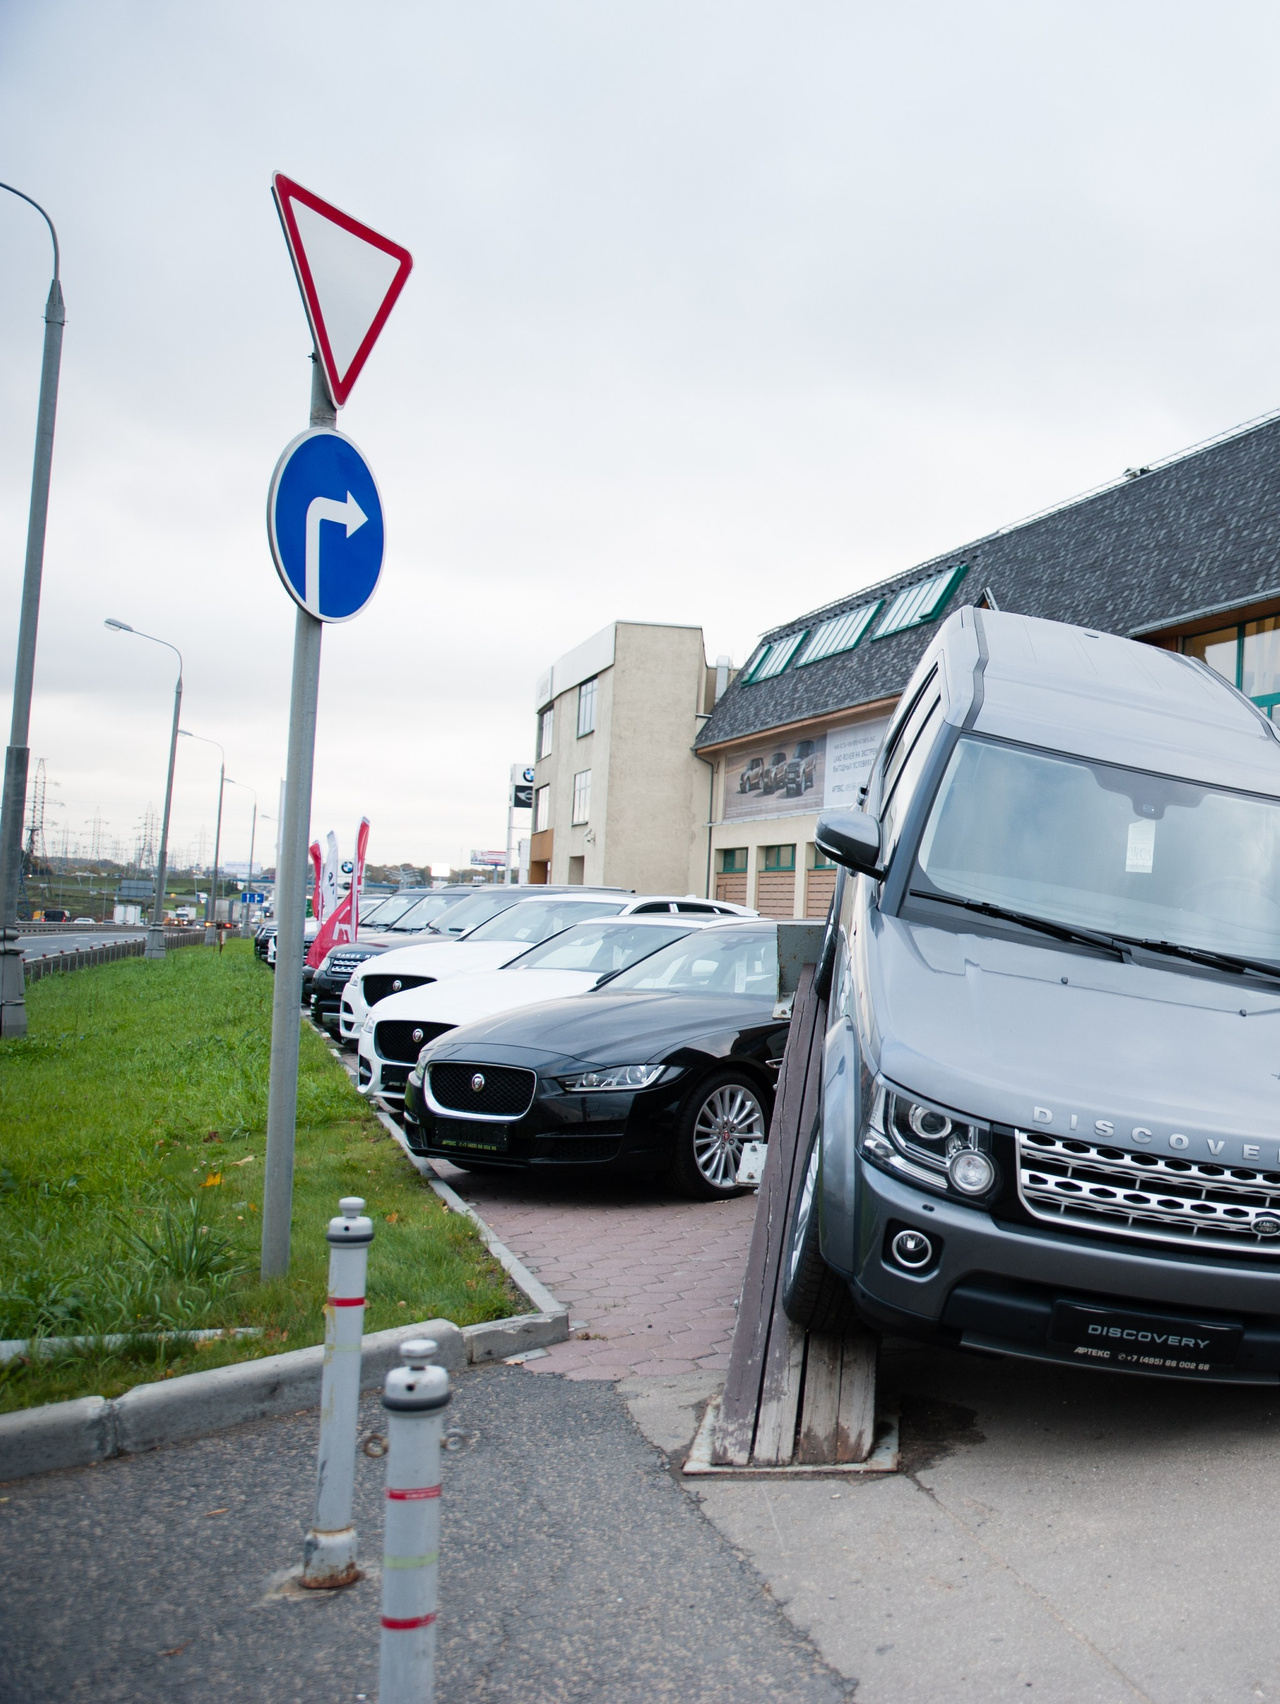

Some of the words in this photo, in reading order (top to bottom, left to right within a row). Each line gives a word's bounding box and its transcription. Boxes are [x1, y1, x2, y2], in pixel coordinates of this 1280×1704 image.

[1087, 1324, 1210, 1348] DISCOVERY
[1074, 1346, 1111, 1358] АРТЕКС
[1139, 1355, 1163, 1366] (495)
[1179, 1360, 1197, 1370] 002
